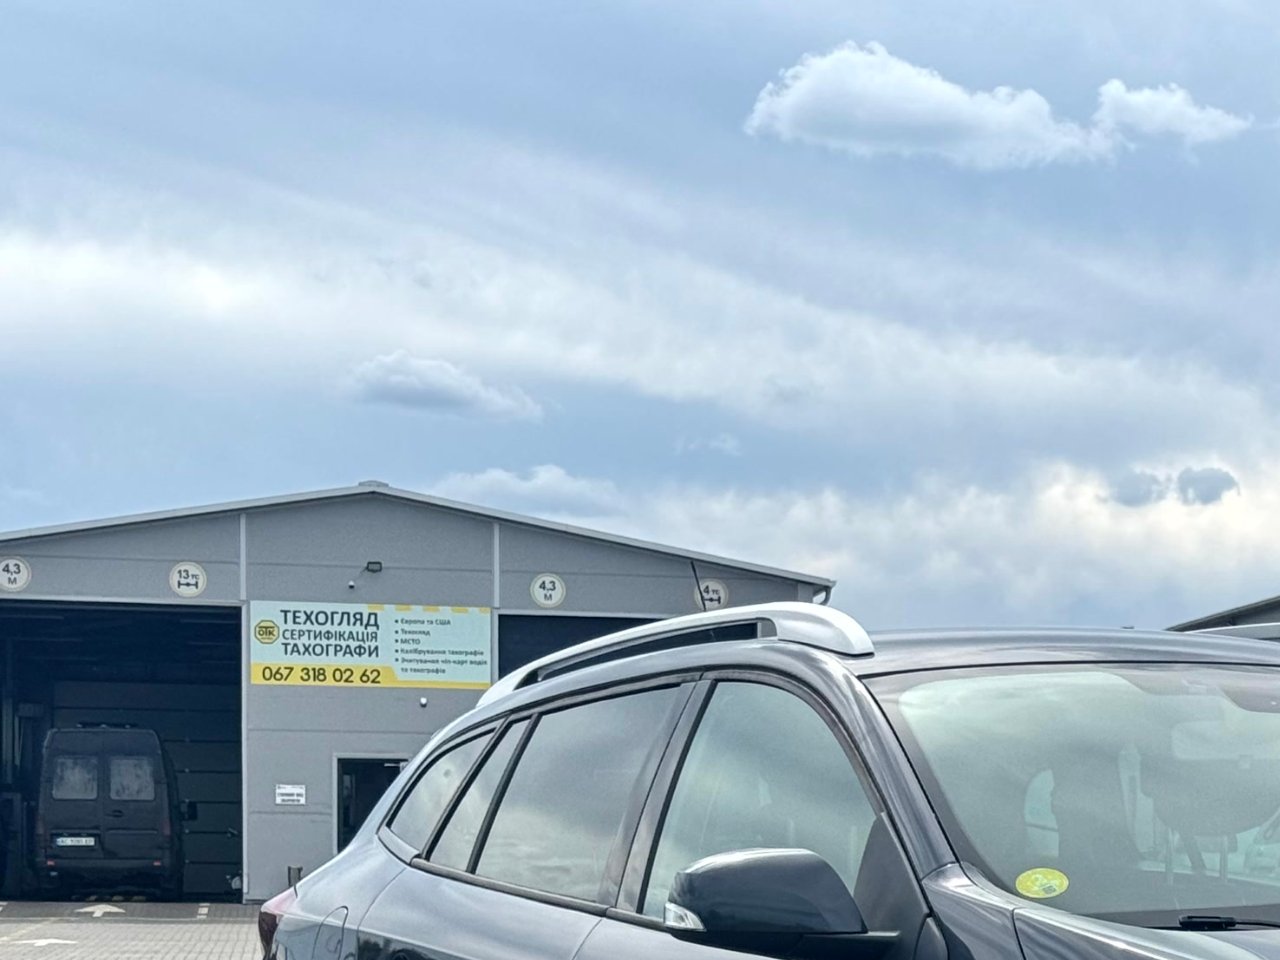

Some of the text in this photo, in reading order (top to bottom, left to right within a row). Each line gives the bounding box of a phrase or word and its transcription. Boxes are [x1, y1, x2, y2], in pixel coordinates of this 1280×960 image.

[2, 563, 21, 575] 4,3
[177, 569, 190, 580] 13
[280, 609, 380, 631] ТЕХОГЛЯД
[282, 628, 378, 644] СЕРТИФІКАЦІЯ
[281, 642, 379, 658] ТАХОГРАФИ
[262, 666, 381, 684] 067 318 02 62
